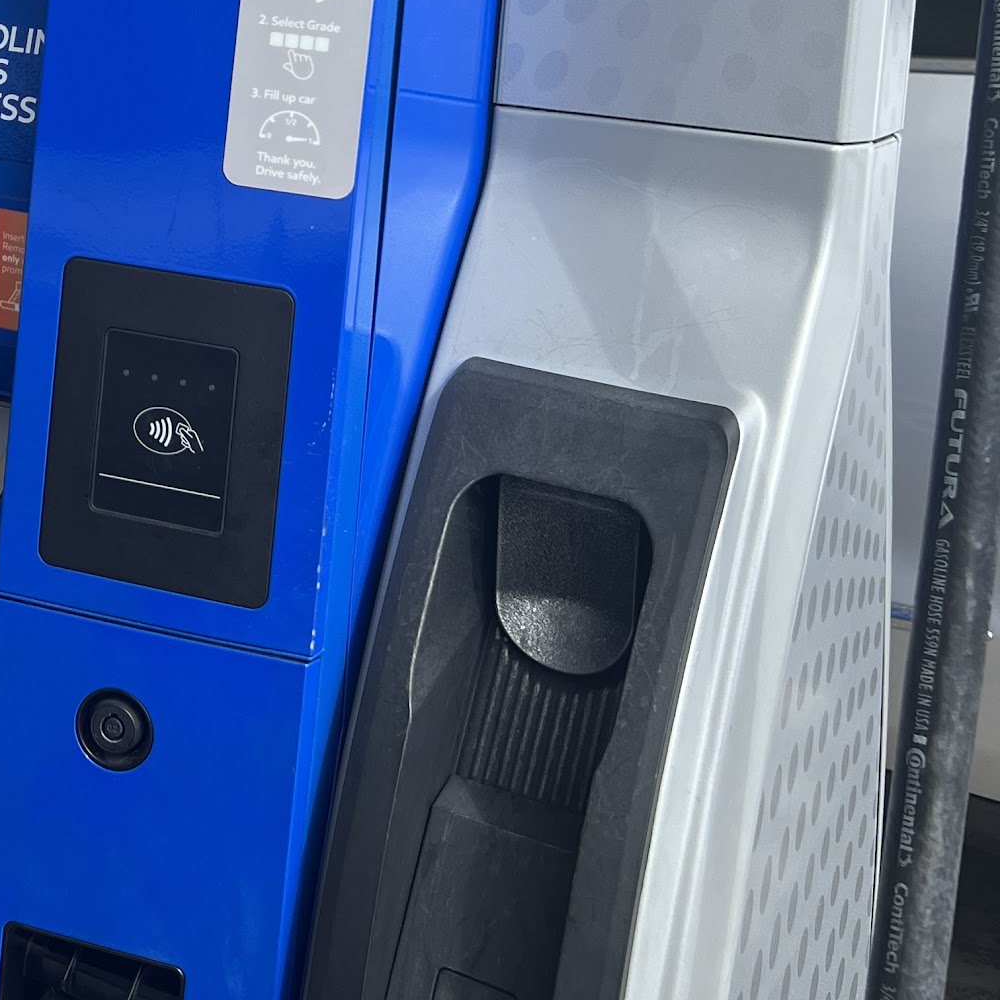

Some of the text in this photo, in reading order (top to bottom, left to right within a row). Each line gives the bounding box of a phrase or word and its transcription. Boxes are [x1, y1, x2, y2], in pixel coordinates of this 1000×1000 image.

[258, 14, 341, 33] 2. Select Grade
[251, 88, 316, 105] 3. Fill up car
[257, 151, 317, 169] Thank you.
[255, 165, 321, 186] Drive safely.
[930, 538, 950, 596] GASOLINE
[926, 597, 945, 626] HOSE
